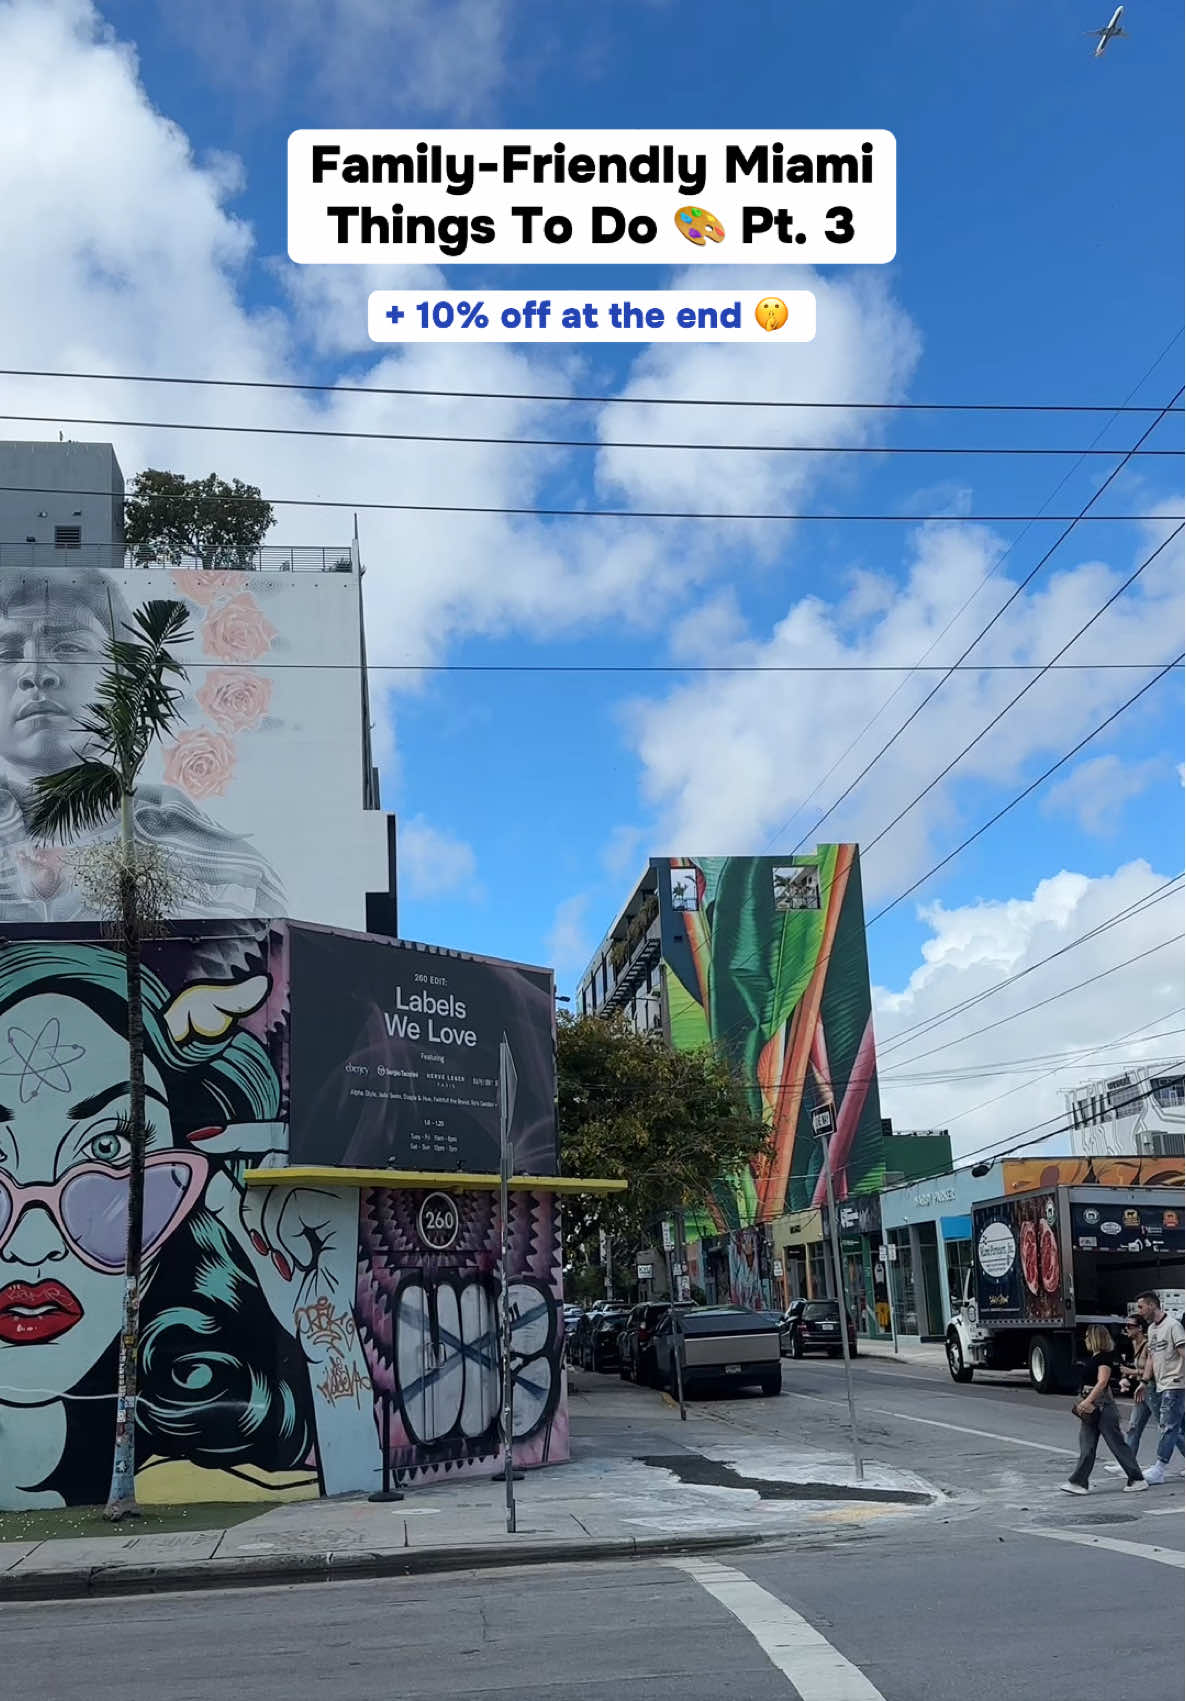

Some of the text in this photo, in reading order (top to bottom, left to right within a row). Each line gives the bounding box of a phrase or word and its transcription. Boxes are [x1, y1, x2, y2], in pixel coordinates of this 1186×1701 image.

[414, 973, 447, 986] 260 EDIT:
[396, 986, 466, 1019] Labels
[384, 1012, 477, 1047] We Love
[425, 1211, 454, 1229] 260
